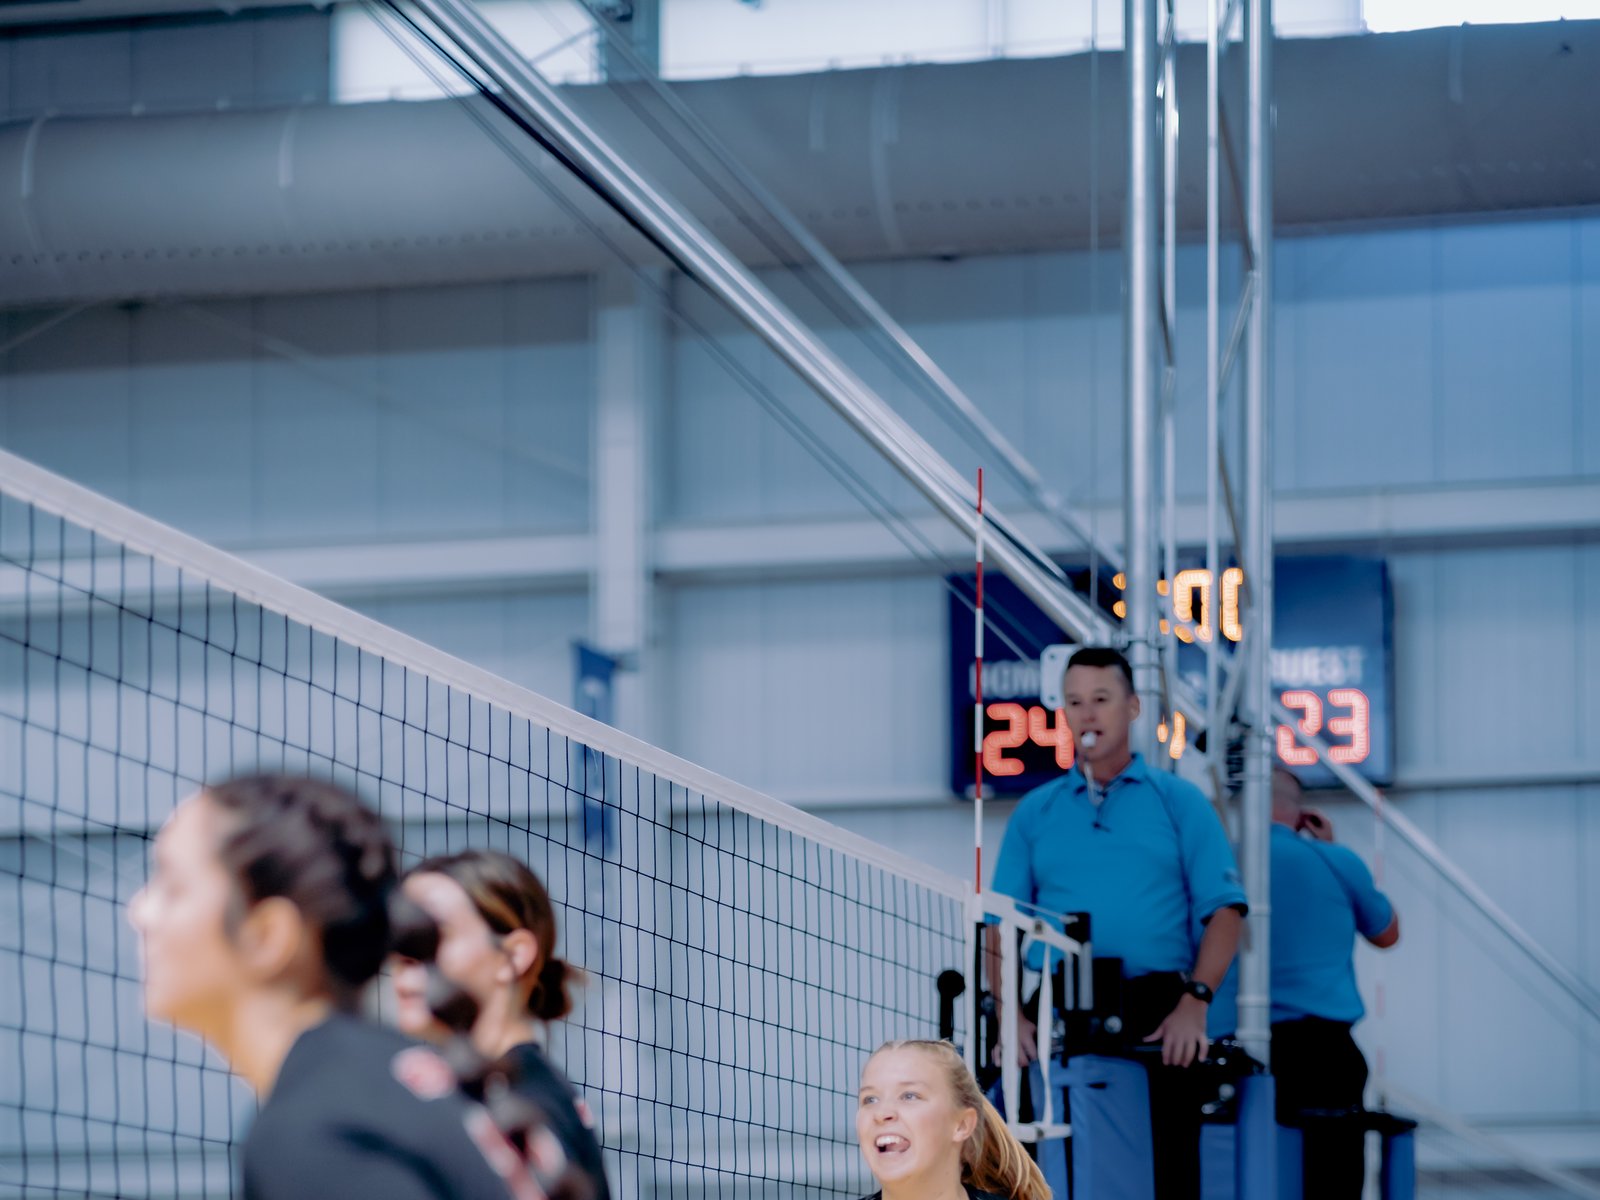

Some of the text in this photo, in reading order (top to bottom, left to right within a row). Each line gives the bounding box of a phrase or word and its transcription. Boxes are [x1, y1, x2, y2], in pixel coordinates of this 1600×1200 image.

[969, 661, 1041, 698] HOM
[983, 703, 1075, 776] 24
[1276, 688, 1370, 766] 23
